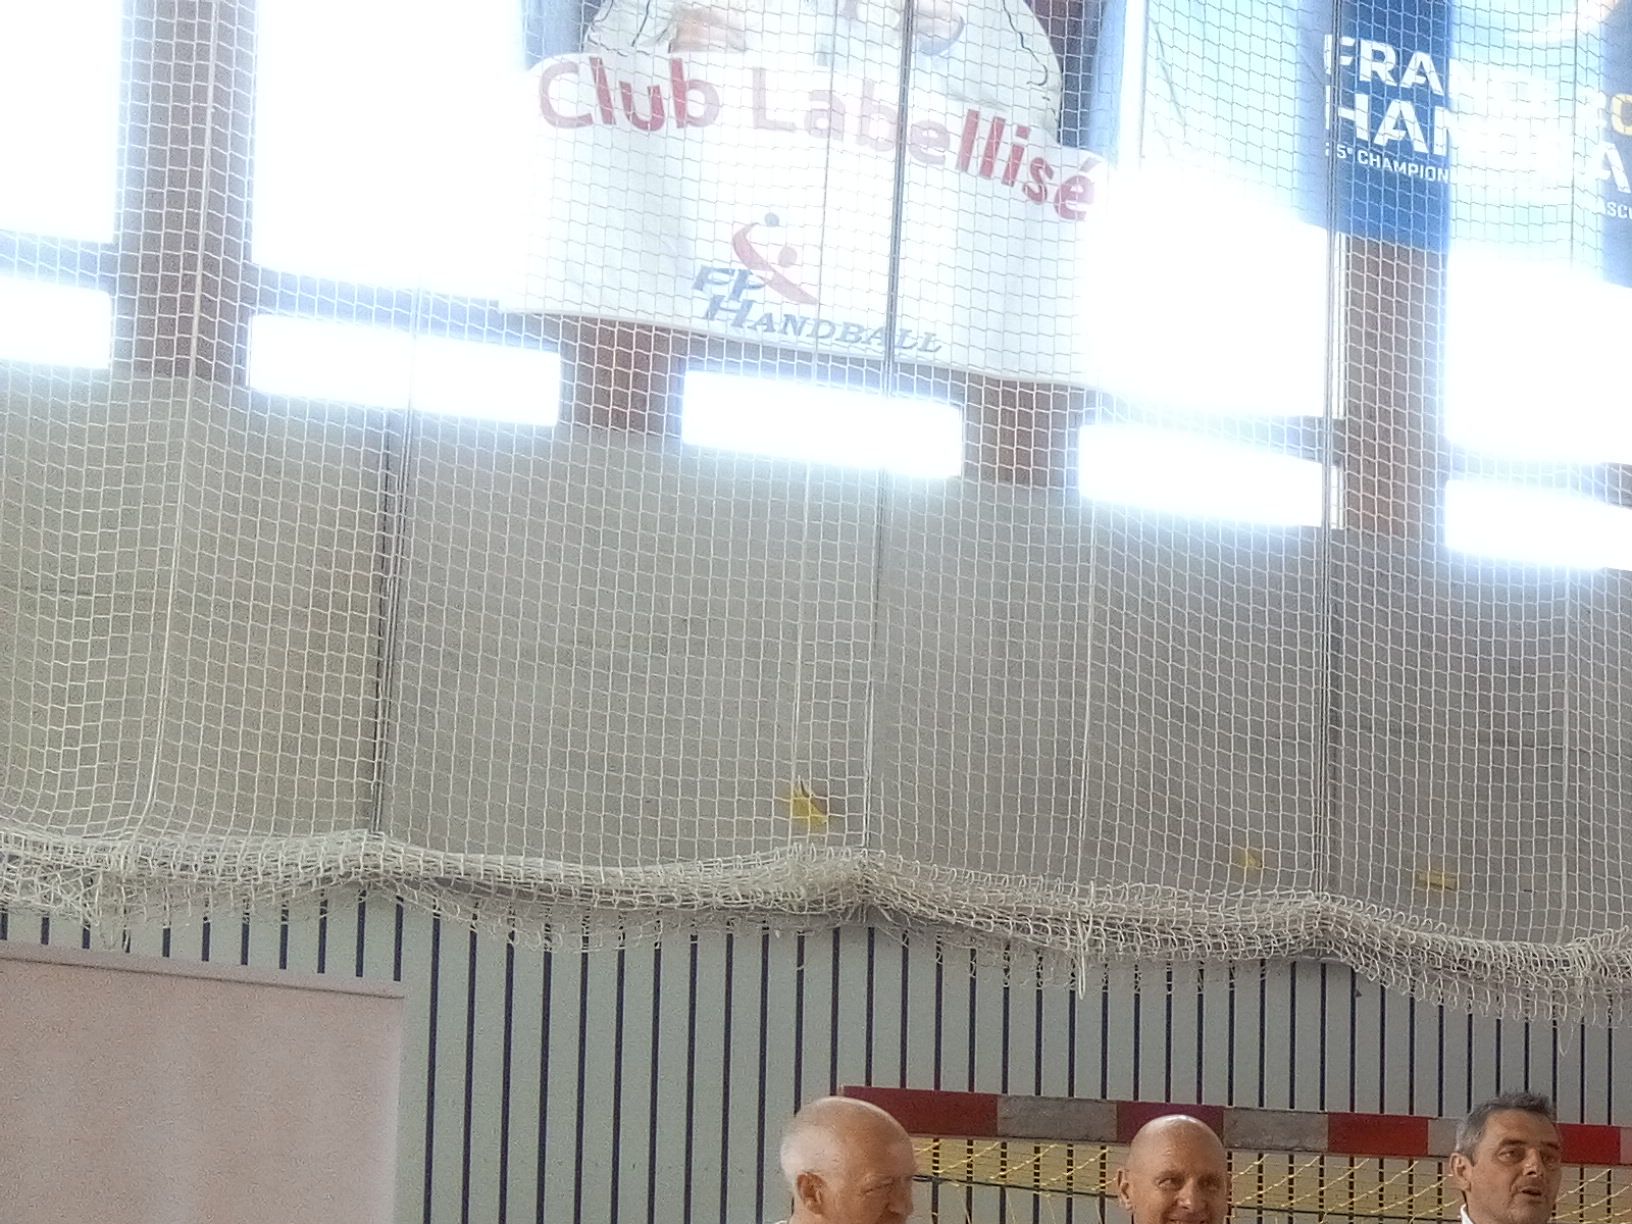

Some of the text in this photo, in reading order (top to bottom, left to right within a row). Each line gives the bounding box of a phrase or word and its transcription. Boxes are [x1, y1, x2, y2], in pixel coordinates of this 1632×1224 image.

[538, 57, 1100, 222] Club Labellisé
[1357, 149, 1450, 184] CHAMPION
[702, 295, 943, 354] HANDBALL
